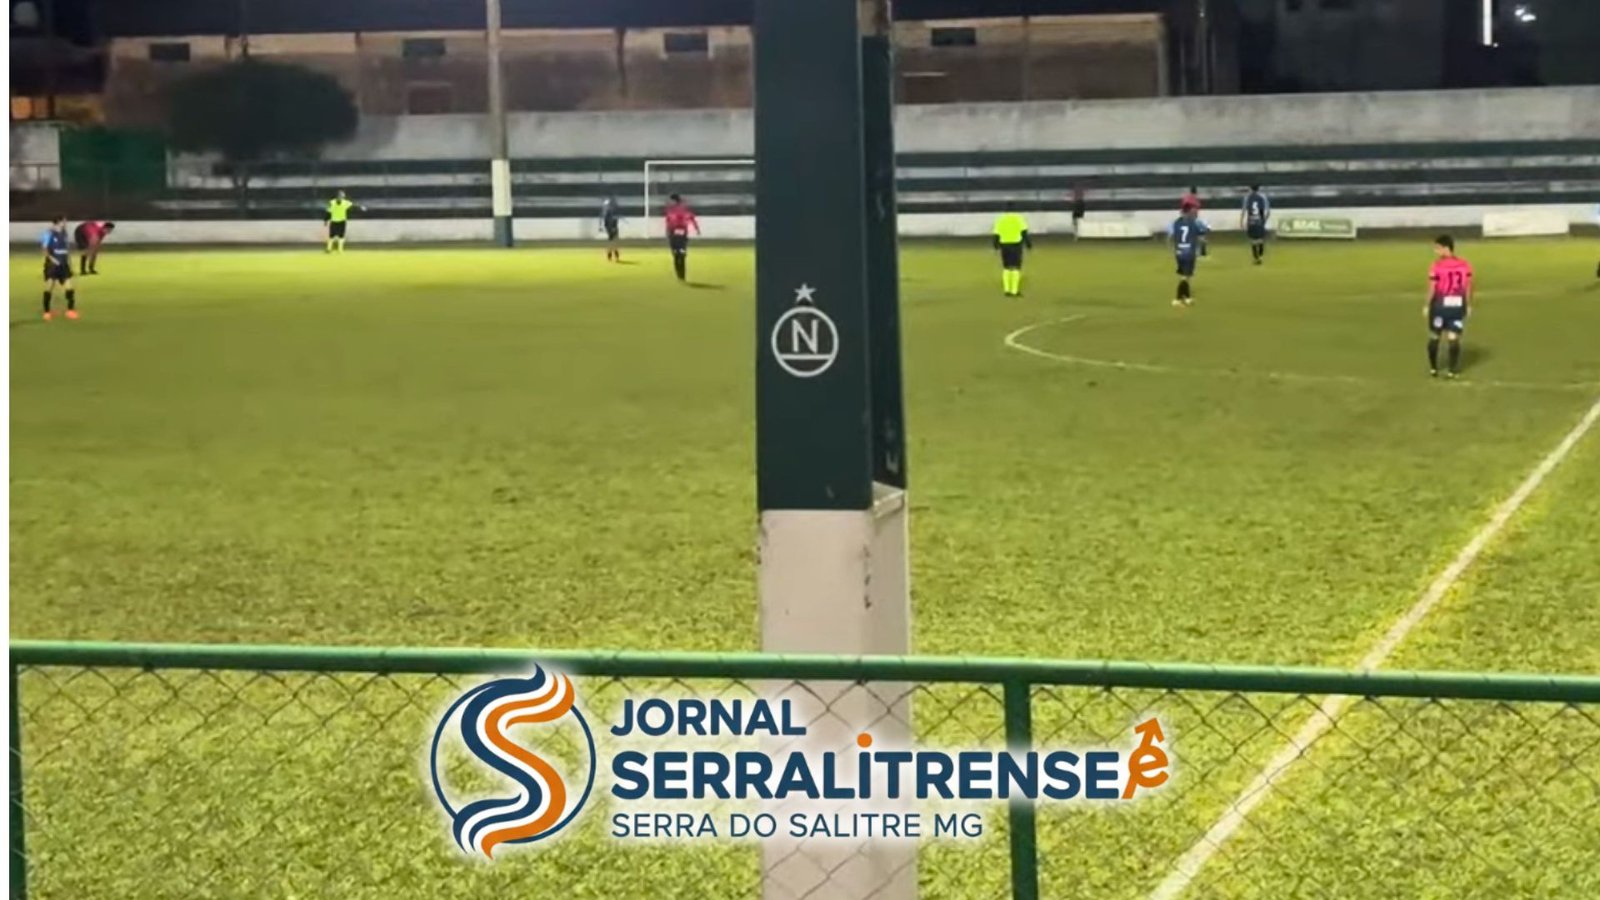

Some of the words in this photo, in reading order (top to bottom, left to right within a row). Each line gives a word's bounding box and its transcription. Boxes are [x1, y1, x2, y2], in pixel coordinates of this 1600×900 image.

[1181, 226, 1189, 242] 7
[1447, 271, 1463, 294] 13
[791, 319, 818, 353] N
